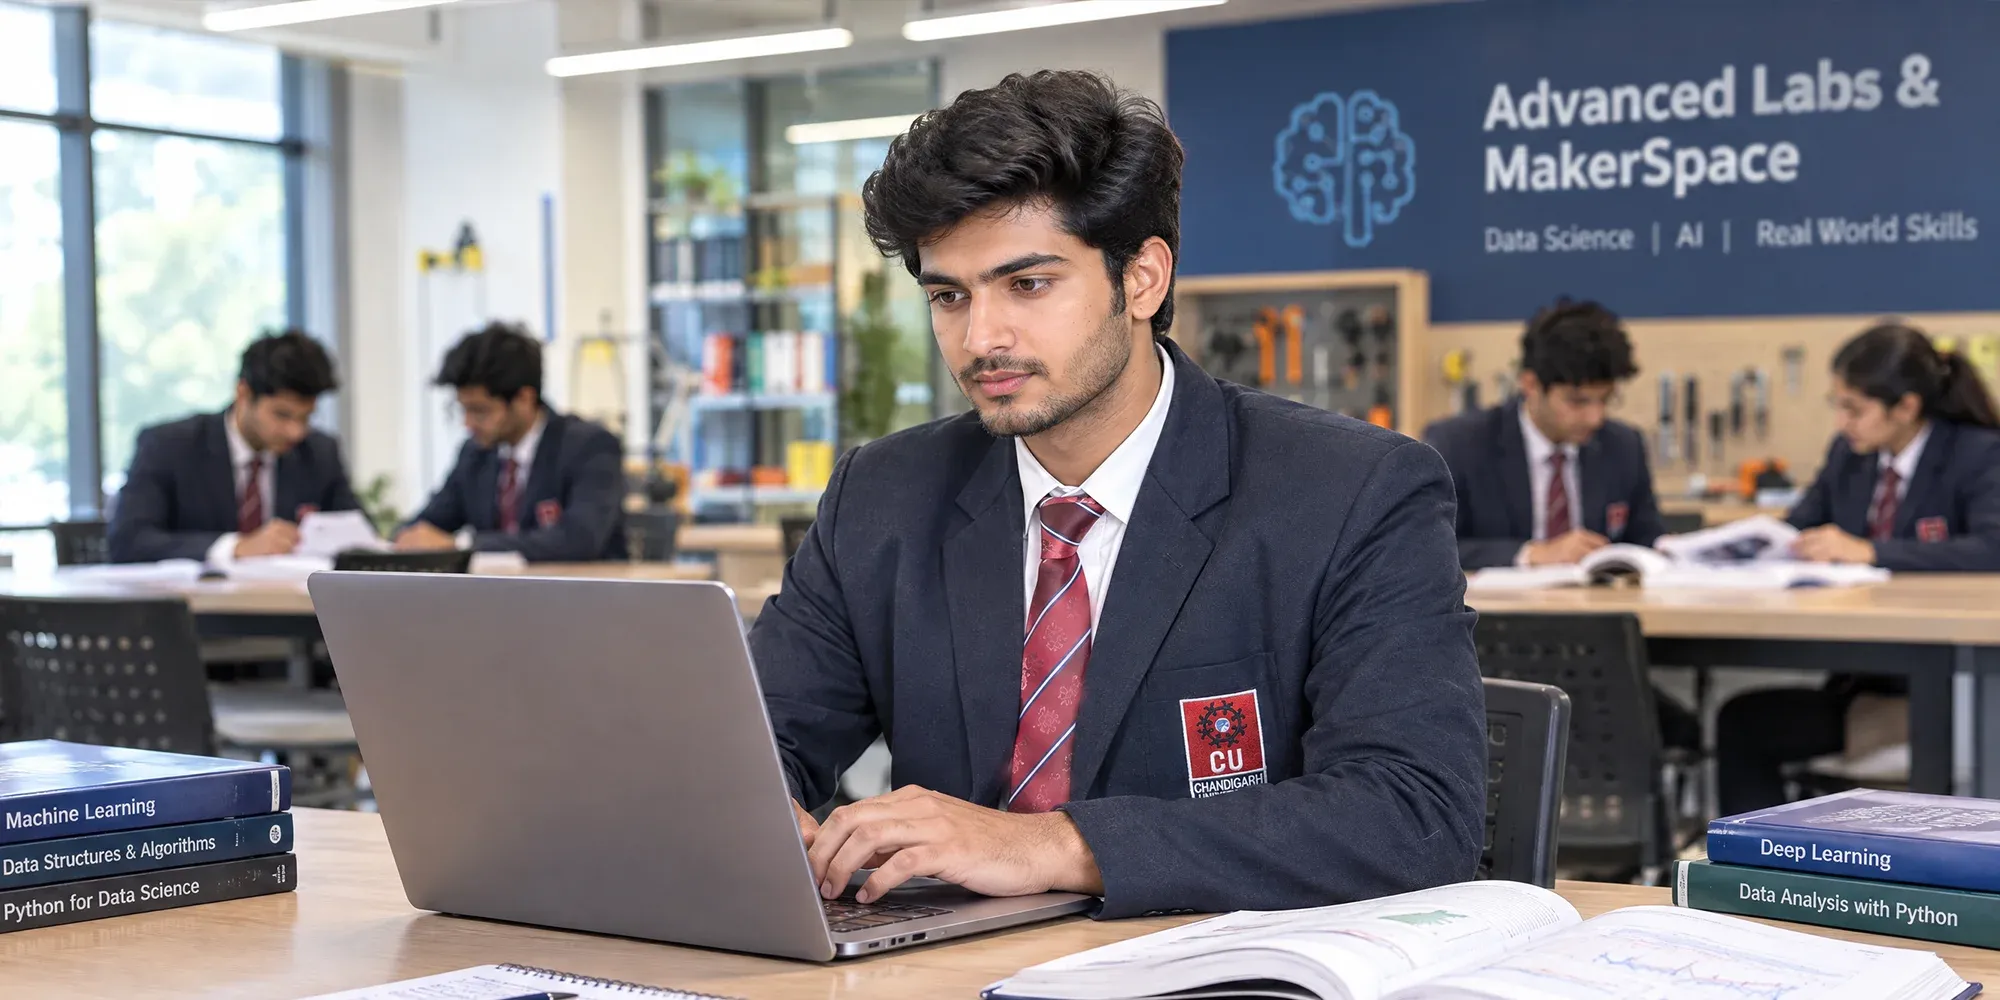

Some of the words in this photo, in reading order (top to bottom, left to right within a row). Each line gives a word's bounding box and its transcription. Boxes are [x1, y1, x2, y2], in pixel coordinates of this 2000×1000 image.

[1483, 64, 1736, 131] Advanced
[1753, 58, 1883, 115] Labs
[1897, 54, 1940, 108] &
[1485, 137, 1800, 198] MakerSpace
[1485, 227, 1538, 252] Data
[1544, 224, 1634, 251] Science
[1676, 222, 1703, 248] AI
[1757, 218, 1812, 246] Real
[1818, 214, 1898, 245] World
[1906, 211, 1978, 243] Skills
[1209, 748, 1243, 773] CU
[1194, 773, 1263, 793] CHANDIGARH
[6, 806, 79, 830] Machine
[85, 798, 156, 820] Learning
[3, 857, 39, 876] Data
[44, 847, 121, 871] Structures
[126, 844, 137, 860] &
[140, 836, 216, 860] Algorithms
[1761, 838, 1806, 863] Deep
[1812, 843, 1892, 871] Learning
[4, 898, 64, 923] Python
[70, 893, 93, 912] for
[98, 888, 136, 908] Data
[140, 880, 200, 902] Science
[1739, 883, 1775, 904] Data
[1780, 887, 1849, 914] Analysis
[1854, 898, 1890, 919] with
[1896, 902, 1958, 927] Python
